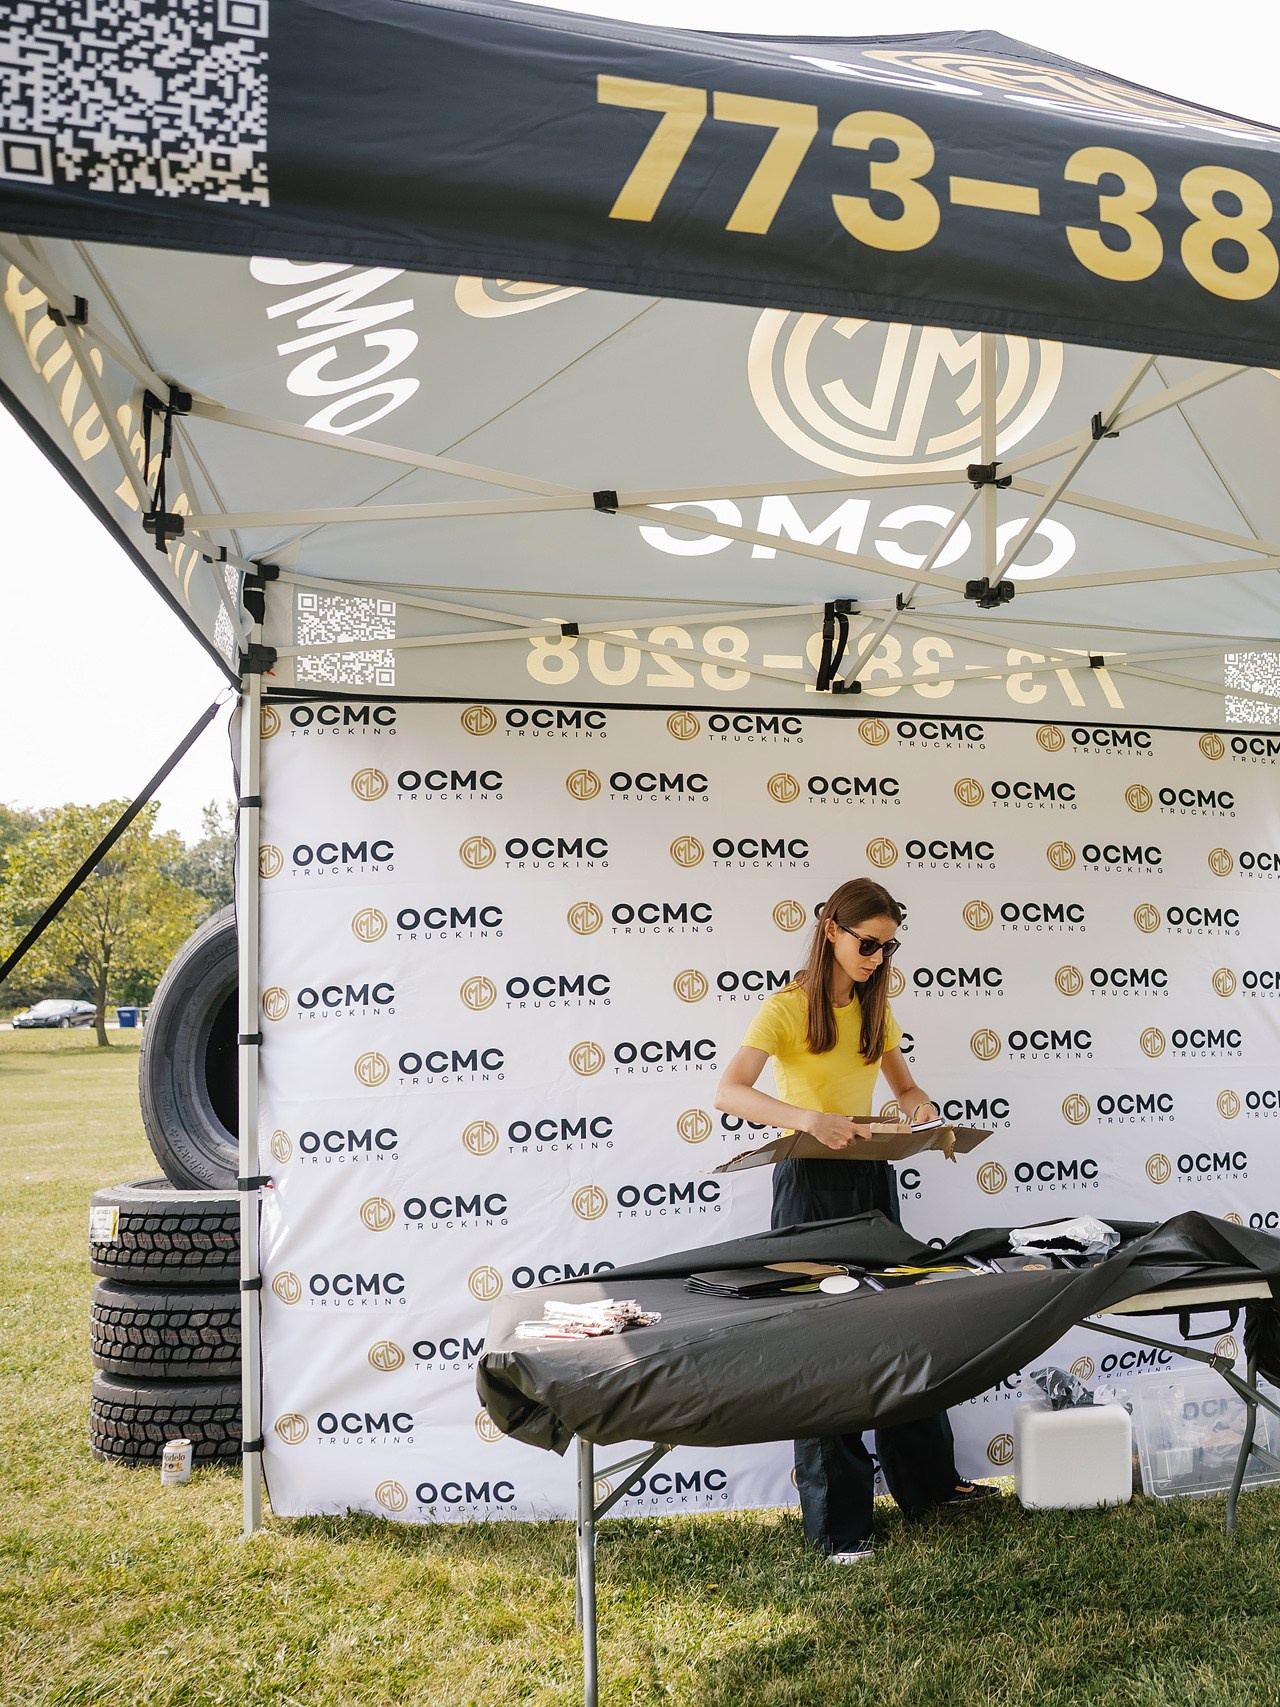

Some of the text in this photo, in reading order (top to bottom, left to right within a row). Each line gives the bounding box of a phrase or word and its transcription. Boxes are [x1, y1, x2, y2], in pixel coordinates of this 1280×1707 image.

[289, 704, 397, 728] OCMC
[504, 707, 607, 730] OCMC
[290, 727, 397, 737] TRUCKING
[707, 713, 803, 736] OCMC
[896, 720, 985, 742] OCMC
[504, 729, 608, 739] TRUCKING
[708, 734, 804, 744] TRUCKING
[1070, 727, 1152, 749] OCMC
[897, 740, 986, 750] TRUCKING
[1072, 746, 1154, 757] TRUCKING
[396, 769, 504, 793] OCMC
[609, 771, 709, 794] OCMC
[807, 775, 900, 797] OCMC
[396, 792, 504, 801] TRUCKING
[609, 793, 710, 803] TRUCKING
[990, 780, 1077, 802] OCMC
[1158, 787, 1235, 810] OCMC
[807, 796, 901, 806] TRUCKING
[991, 800, 1078, 811] TRUCKING
[1159, 807, 1236, 818] TRUCKING
[292, 839, 395, 867] OCMC
[504, 836, 609, 860] OCMC
[712, 837, 810, 860] OCMC
[904, 839, 995, 861] OCMC
[1081, 843, 1163, 866] OCMC
[291, 864, 395, 877] TRUCKING
[504, 860, 609, 869] TRUCKING
[712, 860, 810, 868] TRUCKING
[905, 861, 996, 870] TRUCKING
[1082, 864, 1164, 874] TRUCKING
[396, 905, 504, 931] OCMC
[611, 902, 713, 925] OCMC
[999, 902, 1085, 924] OCMC
[1166, 905, 1240, 928] OCMC
[396, 929, 504, 941] TRUCKING
[611, 925, 714, 935] TRUCKING
[1000, 924, 1086, 933] TRUCKING
[1166, 927, 1241, 937] TRUCKING
[912, 966, 1003, 989] OCMC
[1089, 967, 1169, 989] OCMC
[505, 973, 611, 1000] OCMC
[913, 989, 1004, 998] TRUCKING
[1090, 989, 1169, 997] TRUCKING
[296, 982, 396, 1010] OCMC
[716, 993, 766, 1002] TRUC
[505, 998, 612, 1010] TRUCKING
[297, 1007, 396, 1020] TRUCKING
[1007, 1029, 1093, 1052] OCMC
[1171, 1028, 1243, 1050] OCMC
[613, 1038, 717, 1065] OCMC
[1008, 1051, 1094, 1061] TRUCKING
[1171, 1050, 1243, 1058] TRUCKING
[398, 1047, 505, 1076] OCMC
[613, 1062, 718, 1075] TRUCKING
[398, 1072, 505, 1086] TRUCKING
[1096, 1092, 1174, 1116] OCMC
[1097, 1114, 1175, 1125] TRUCKING
[507, 1115, 614, 1144] OCMC
[720, 1132, 783, 1142] TRUCK
[298, 1127, 399, 1154] OCMC
[507, 1140, 614, 1154] TRUCKING
[299, 1152, 399, 1165] TRUCKING
[1176, 1150, 1248, 1175] OCMC
[1013, 1158, 1099, 1184] OCMC
[1177, 1172, 1248, 1183] TRUCKING
[616, 1179, 721, 1209] OCMC
[1014, 1180, 1099, 1193] TRUCKING
[402, 1192, 508, 1221] OCMC
[616, 1204, 722, 1219] TRUCKING
[403, 1218, 509, 1231] TRUCKING
[308, 1271, 406, 1297] OCMC
[309, 1297, 407, 1307] TRUCKING
[411, 1337, 486, 1361] OCM
[414, 1362, 475, 1372] TRUCK
[1100, 1349, 1174, 1373] OCMC
[316, 1411, 415, 1435] OCMC
[317, 1436, 415, 1445] TRUCKING
[414, 1480, 516, 1503] OCMC
[624, 1492, 729, 1507] TRUCKING
